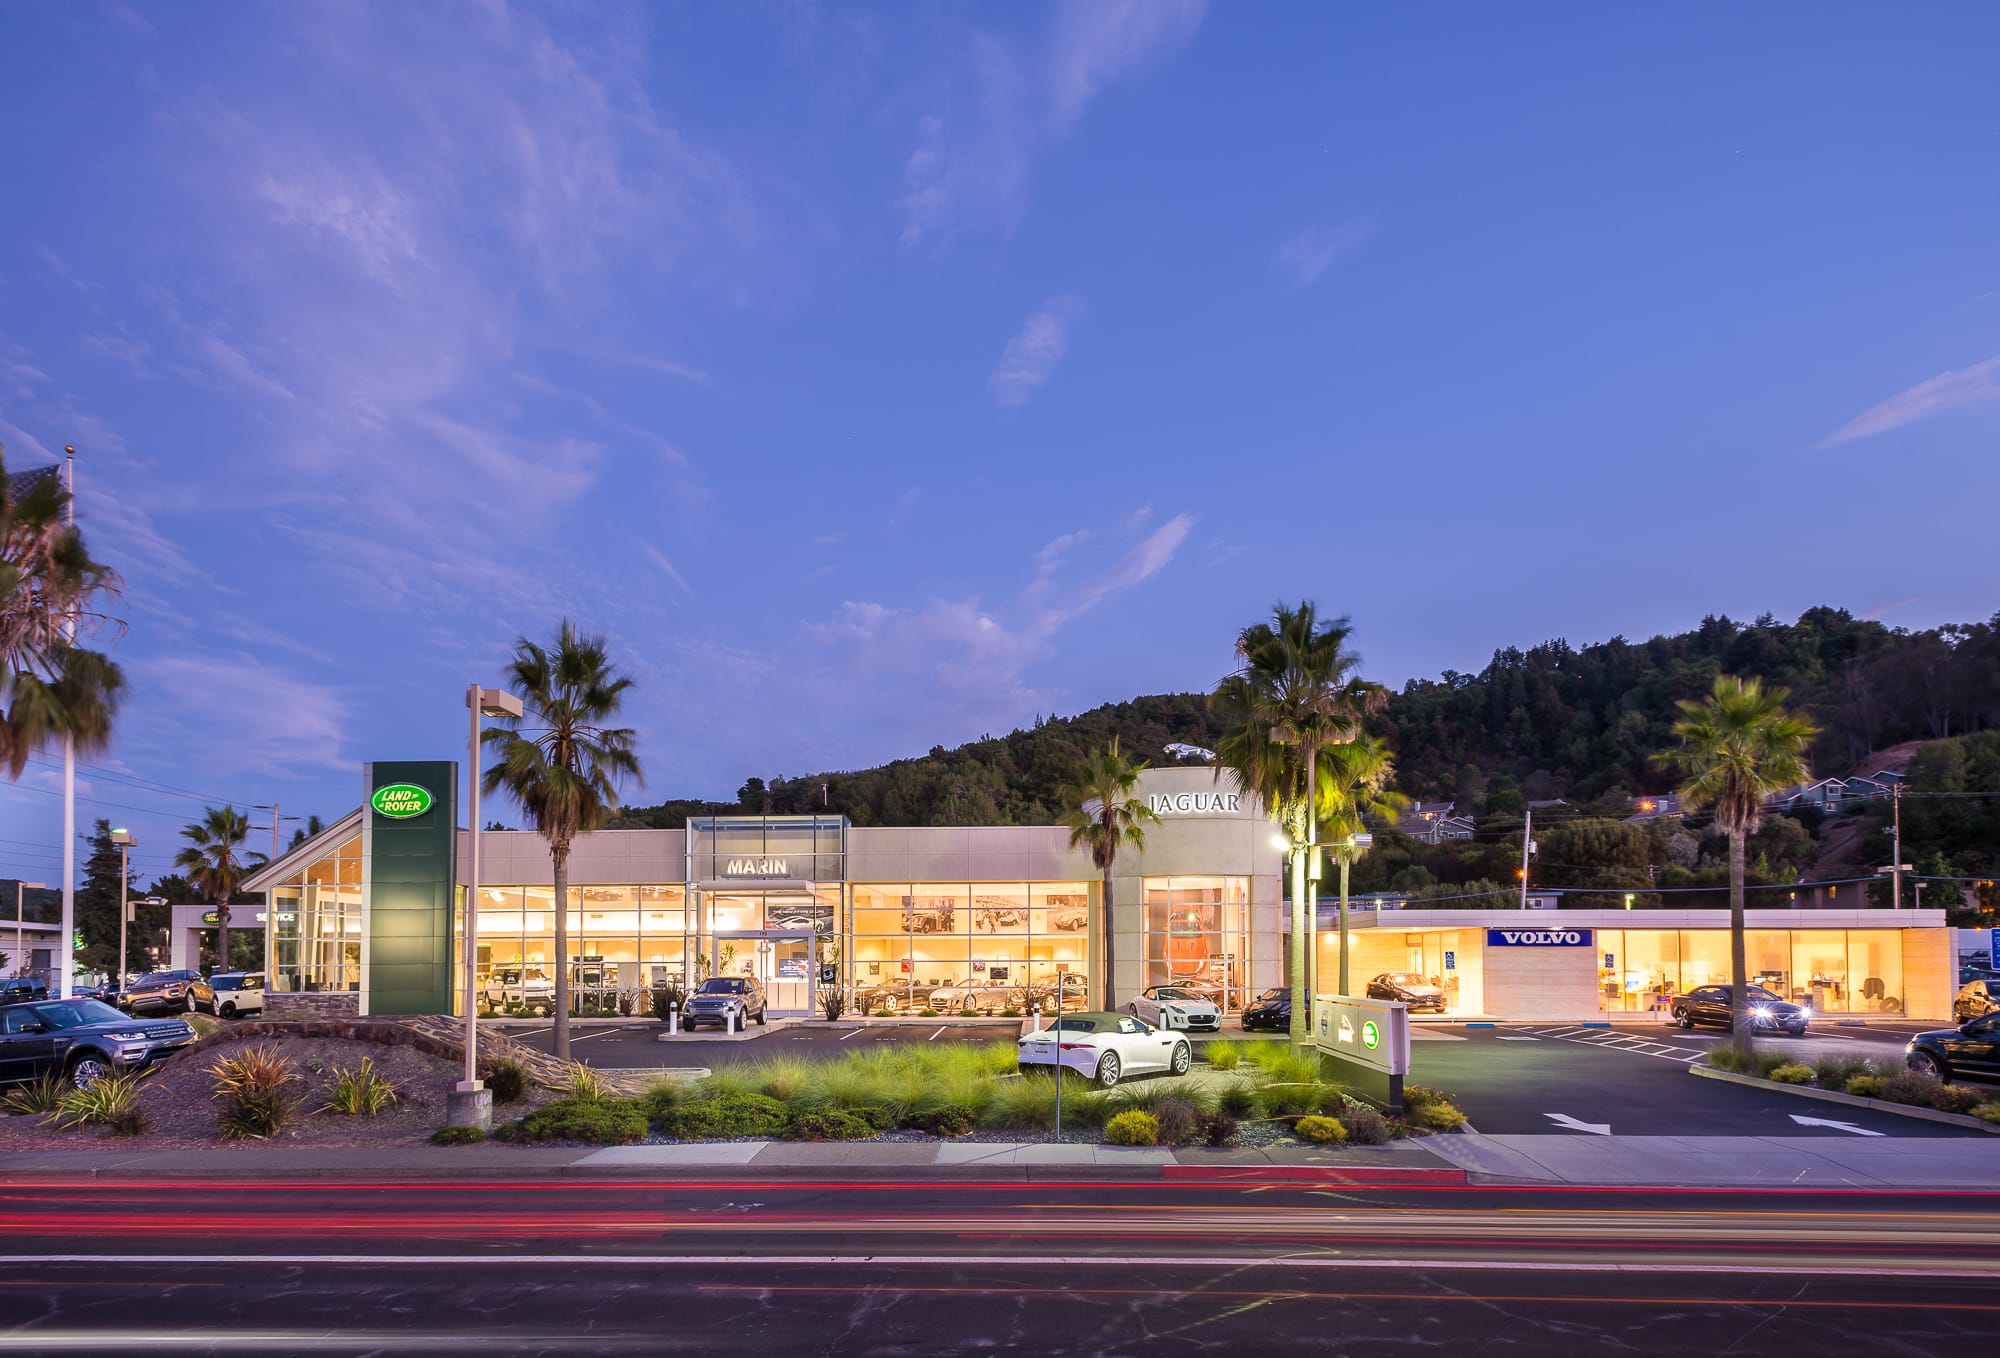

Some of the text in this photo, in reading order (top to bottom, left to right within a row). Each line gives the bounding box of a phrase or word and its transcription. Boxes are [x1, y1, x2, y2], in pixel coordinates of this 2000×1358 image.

[382, 791, 412, 801] LAND
[384, 801, 422, 811] ROVER
[1149, 793, 1240, 814] JAGUAR
[727, 859, 787, 875] MARIN
[256, 912, 295, 922] SEVICE
[1501, 932, 1580, 944] VOLVO
